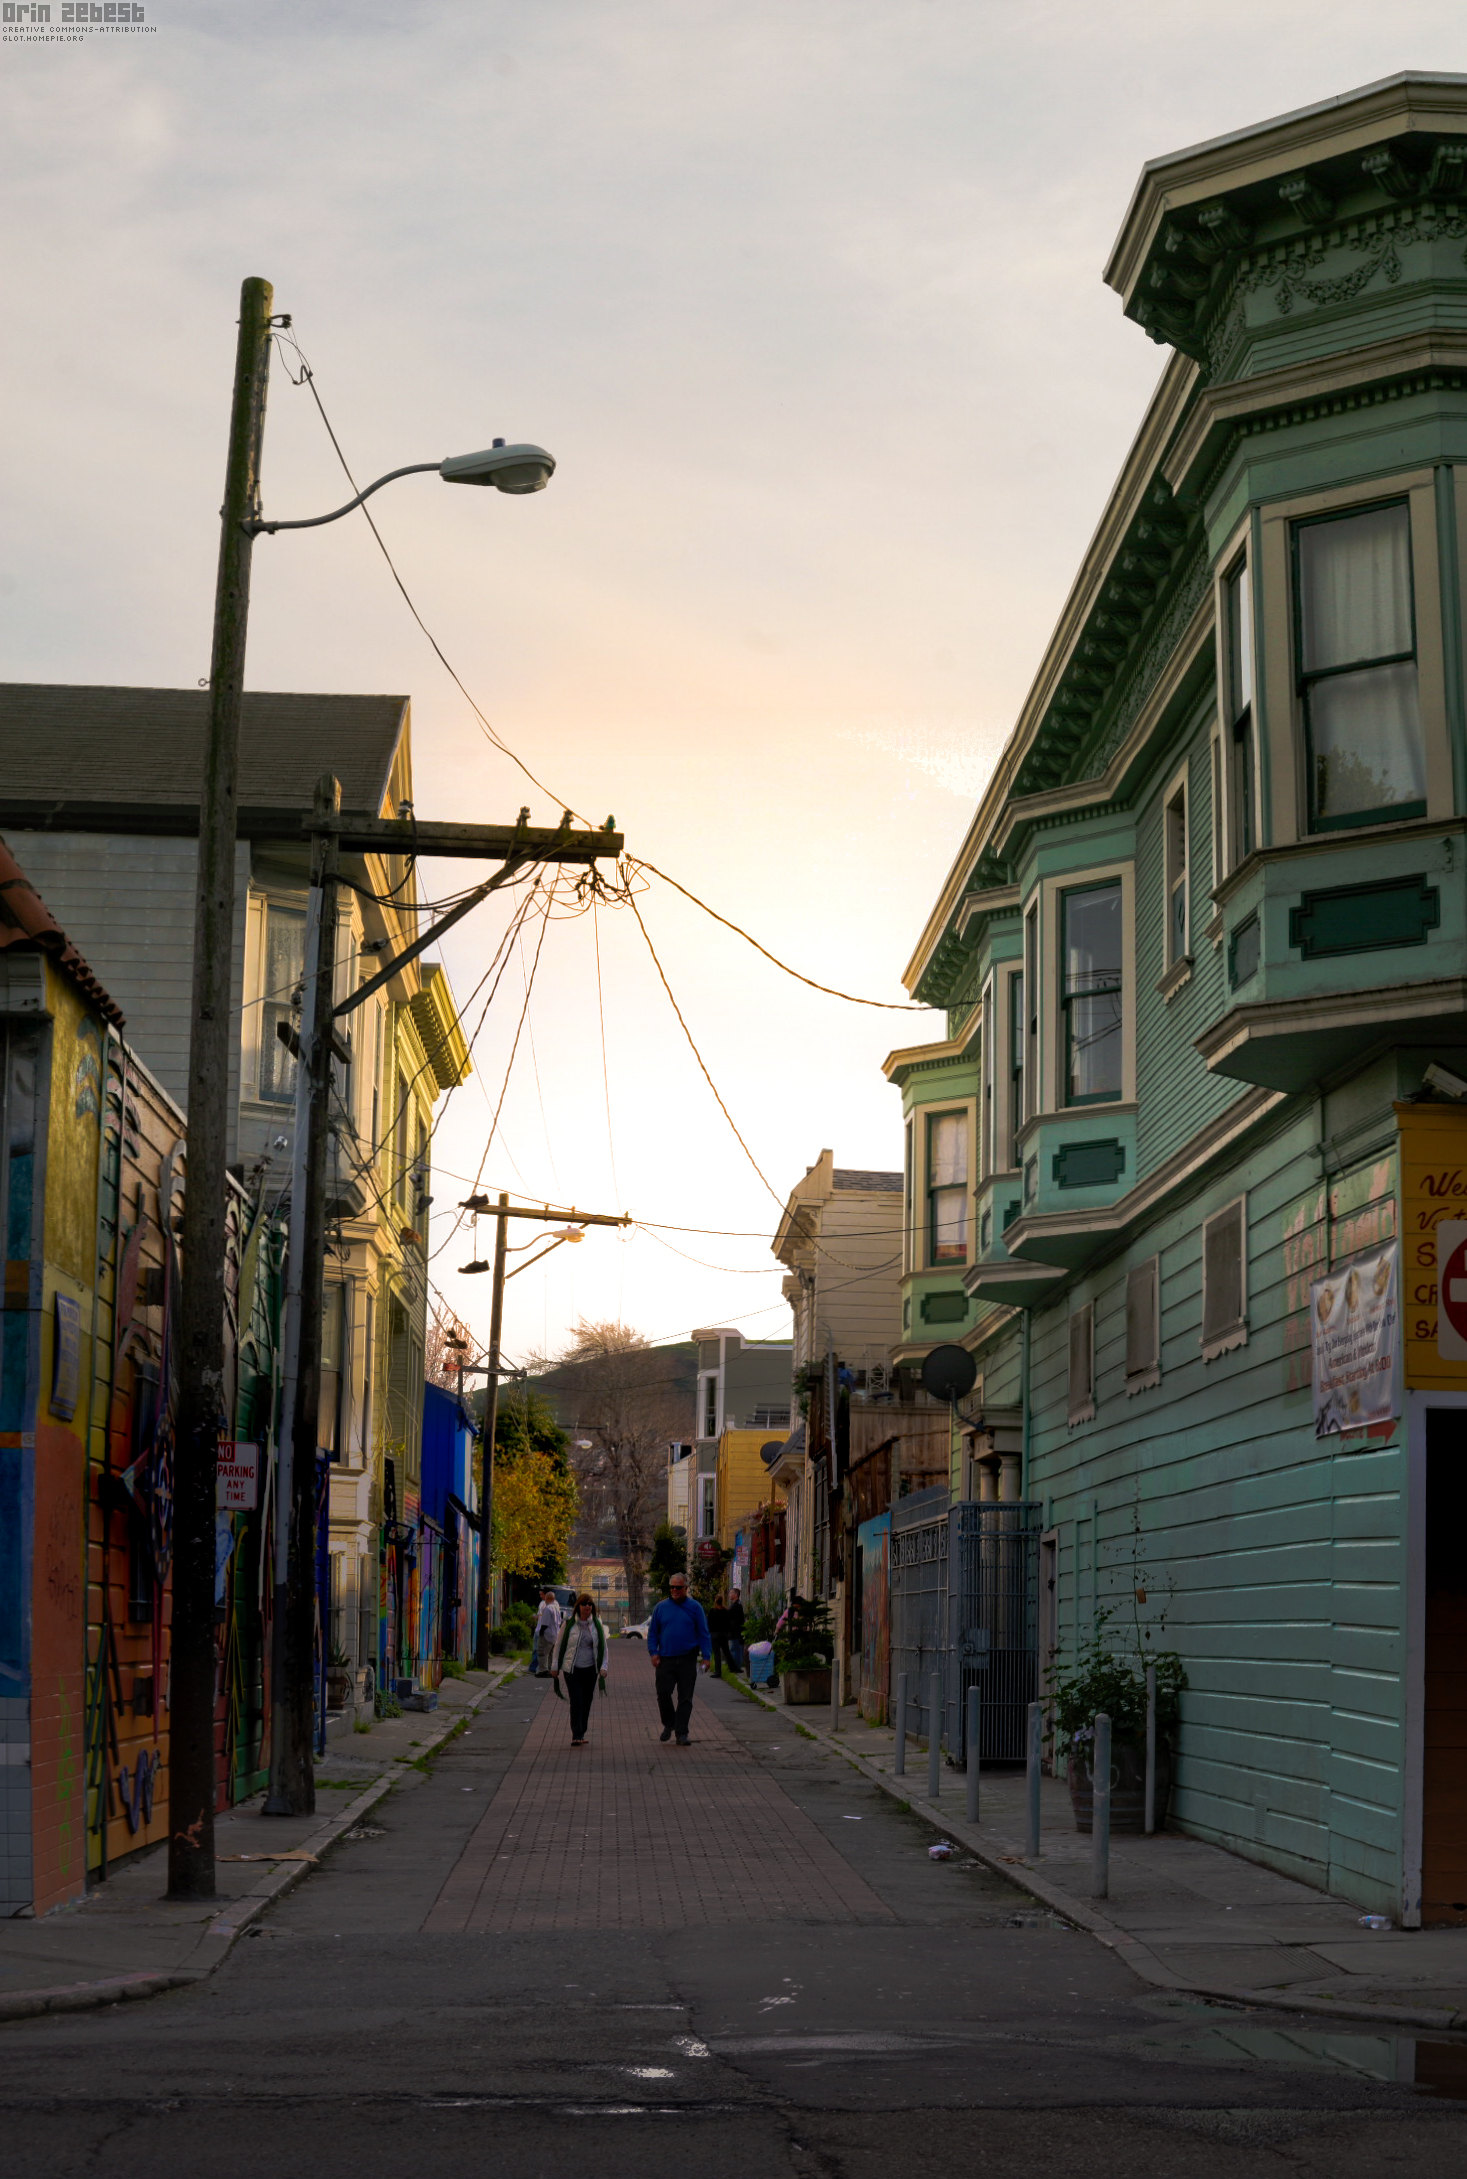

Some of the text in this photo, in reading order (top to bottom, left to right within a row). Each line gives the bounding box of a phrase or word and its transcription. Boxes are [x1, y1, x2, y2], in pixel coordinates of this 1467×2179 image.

[1419, 1169, 1467, 1196] We
[218, 1444, 232, 1460] NO
[217, 1464, 255, 1479] PARKING
[226, 1480, 245, 1489] ANY
[226, 1491, 246, 1502] TIME
